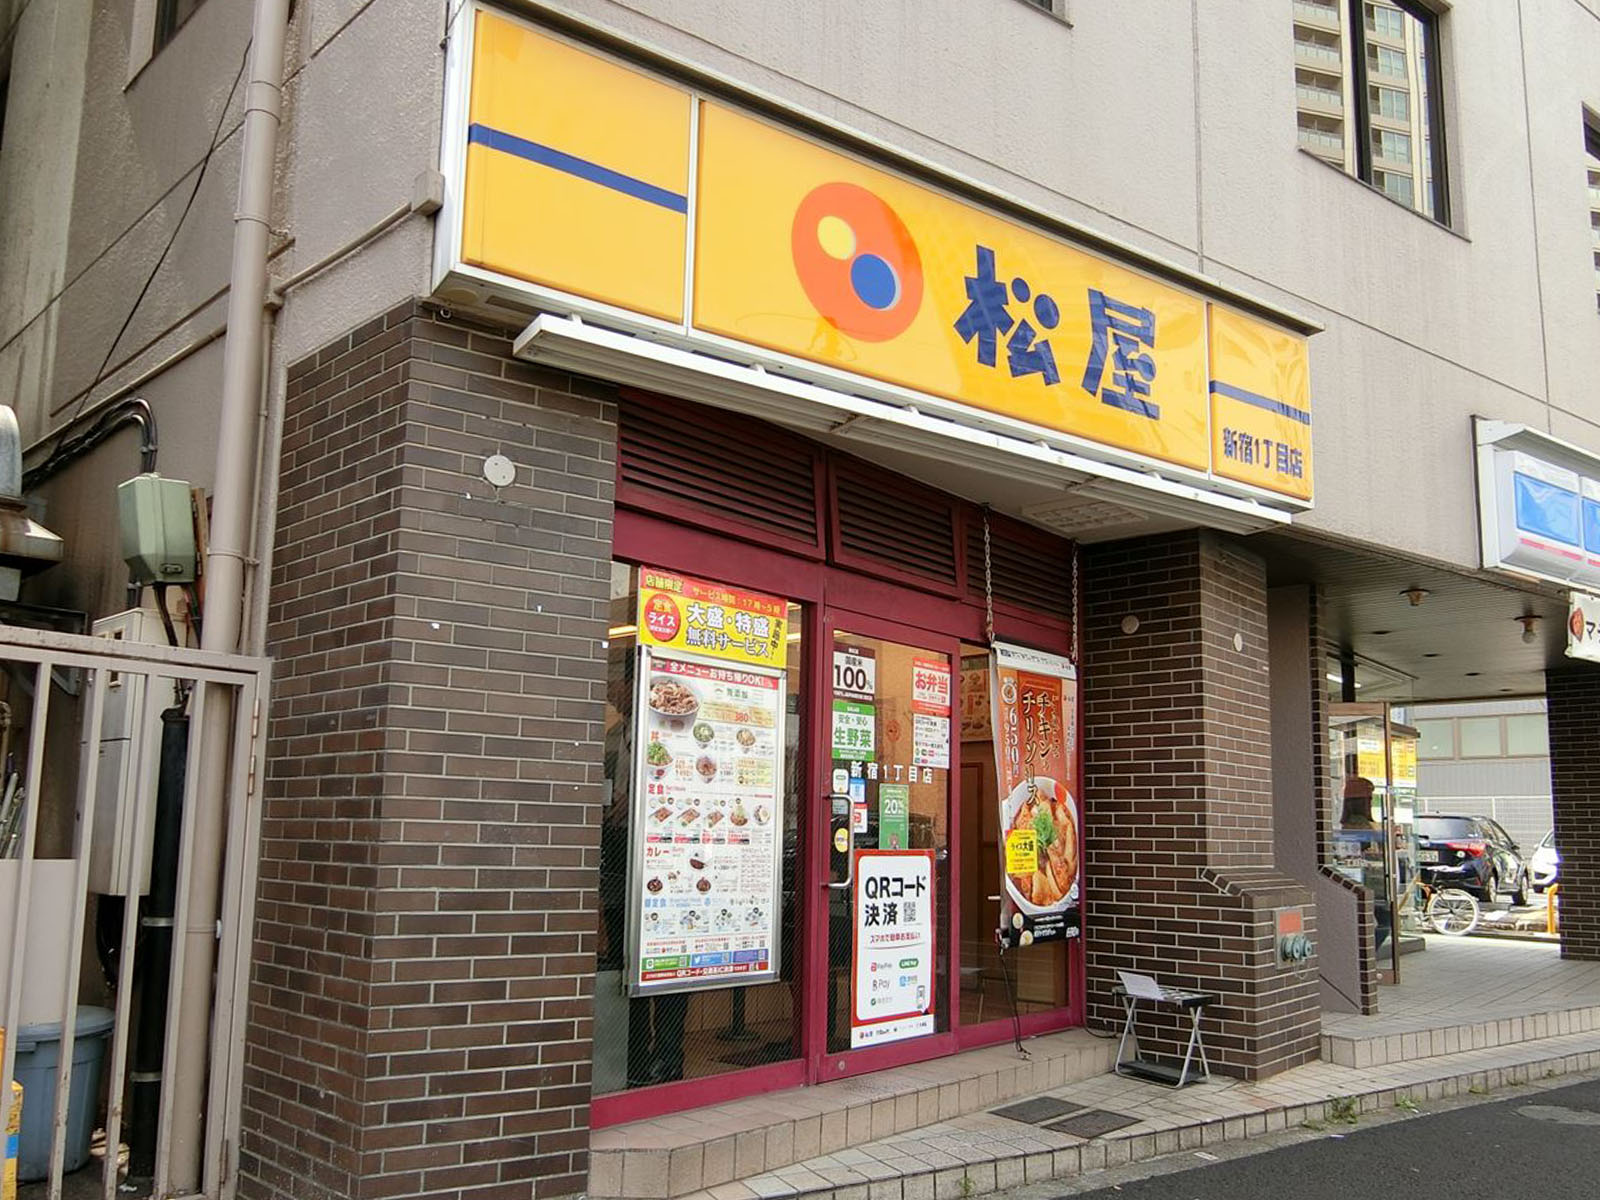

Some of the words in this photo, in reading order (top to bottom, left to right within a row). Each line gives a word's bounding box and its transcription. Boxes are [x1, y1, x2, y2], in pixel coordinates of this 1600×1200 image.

[954, 244, 1160, 421] 松屋
[1223, 426, 1303, 479] 新宿1丁目店
[648, 611, 676, 627] ライス
[686, 602, 770, 639] 大盛・特盛
[686, 626, 771, 659] 無料サービス
[915, 671, 949, 695] お弁当
[834, 726, 872, 748] 生野菜
[1022, 690, 1040, 805] チリソース
[850, 760, 933, 784] 新宿1丁目店
[647, 846, 670, 857] カレー
[865, 874, 926, 899] QRコード
[864, 901, 898, 926] 決済
